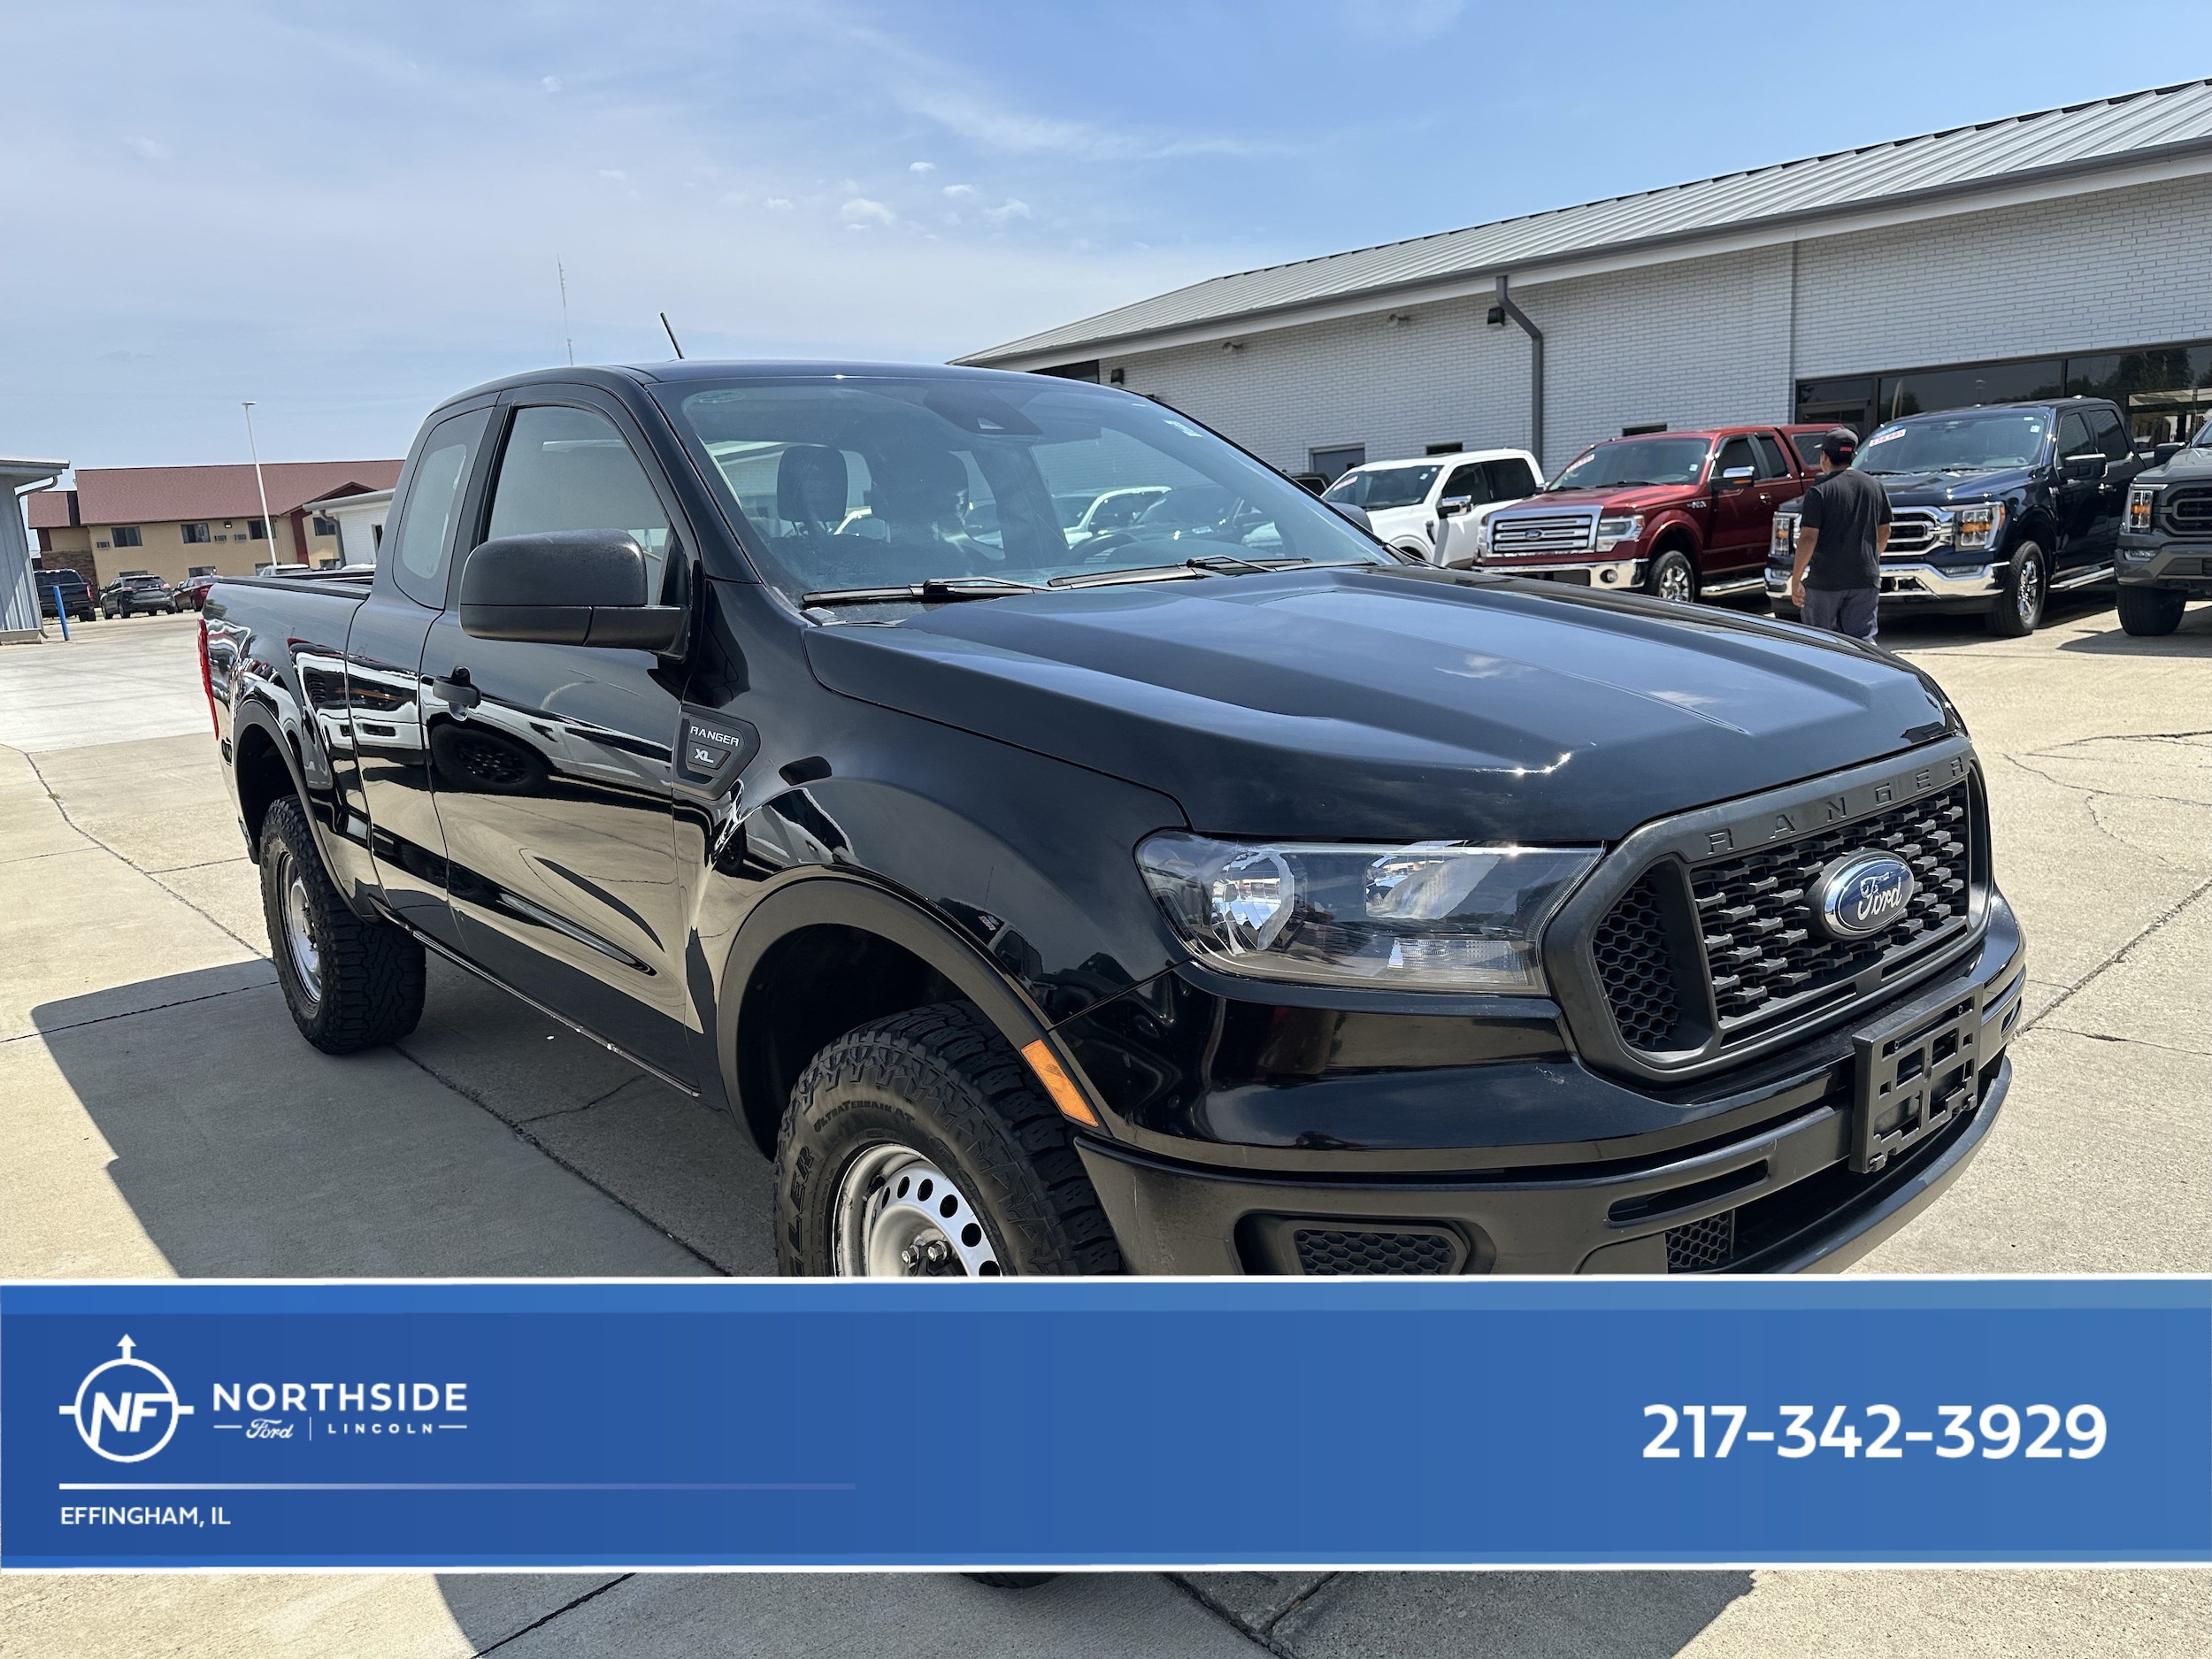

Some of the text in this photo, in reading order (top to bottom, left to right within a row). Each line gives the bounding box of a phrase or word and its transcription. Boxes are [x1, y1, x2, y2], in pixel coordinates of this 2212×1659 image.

[690, 726, 740, 747] RANGER
[694, 748, 714, 764] XL
[1707, 756, 1964, 855] RANGER
[1856, 874, 1903, 921] Ford
